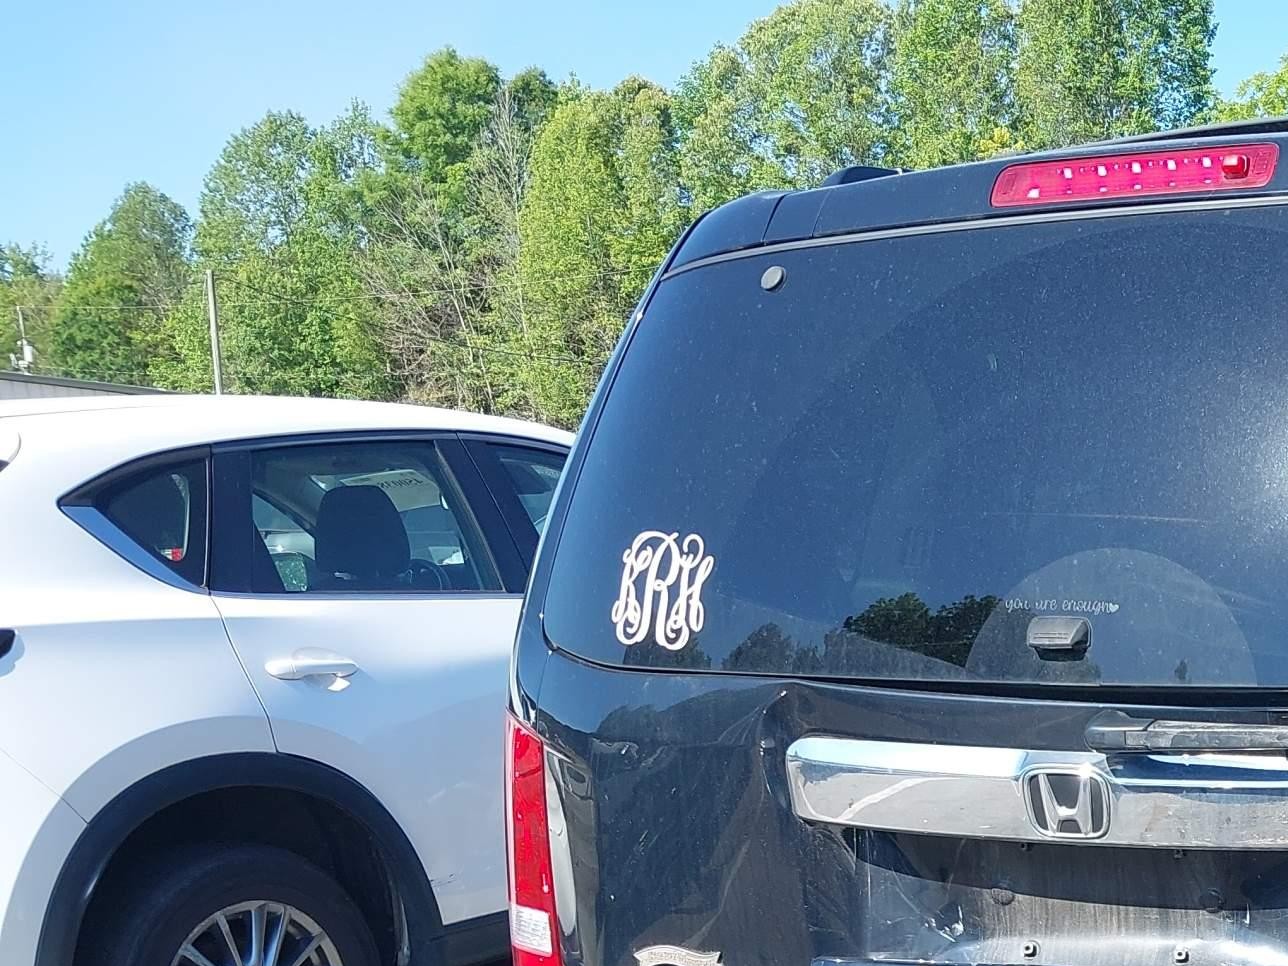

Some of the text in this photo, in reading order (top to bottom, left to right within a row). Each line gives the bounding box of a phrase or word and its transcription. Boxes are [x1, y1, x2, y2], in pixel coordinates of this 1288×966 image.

[1005, 597, 1110, 616] you are enough
